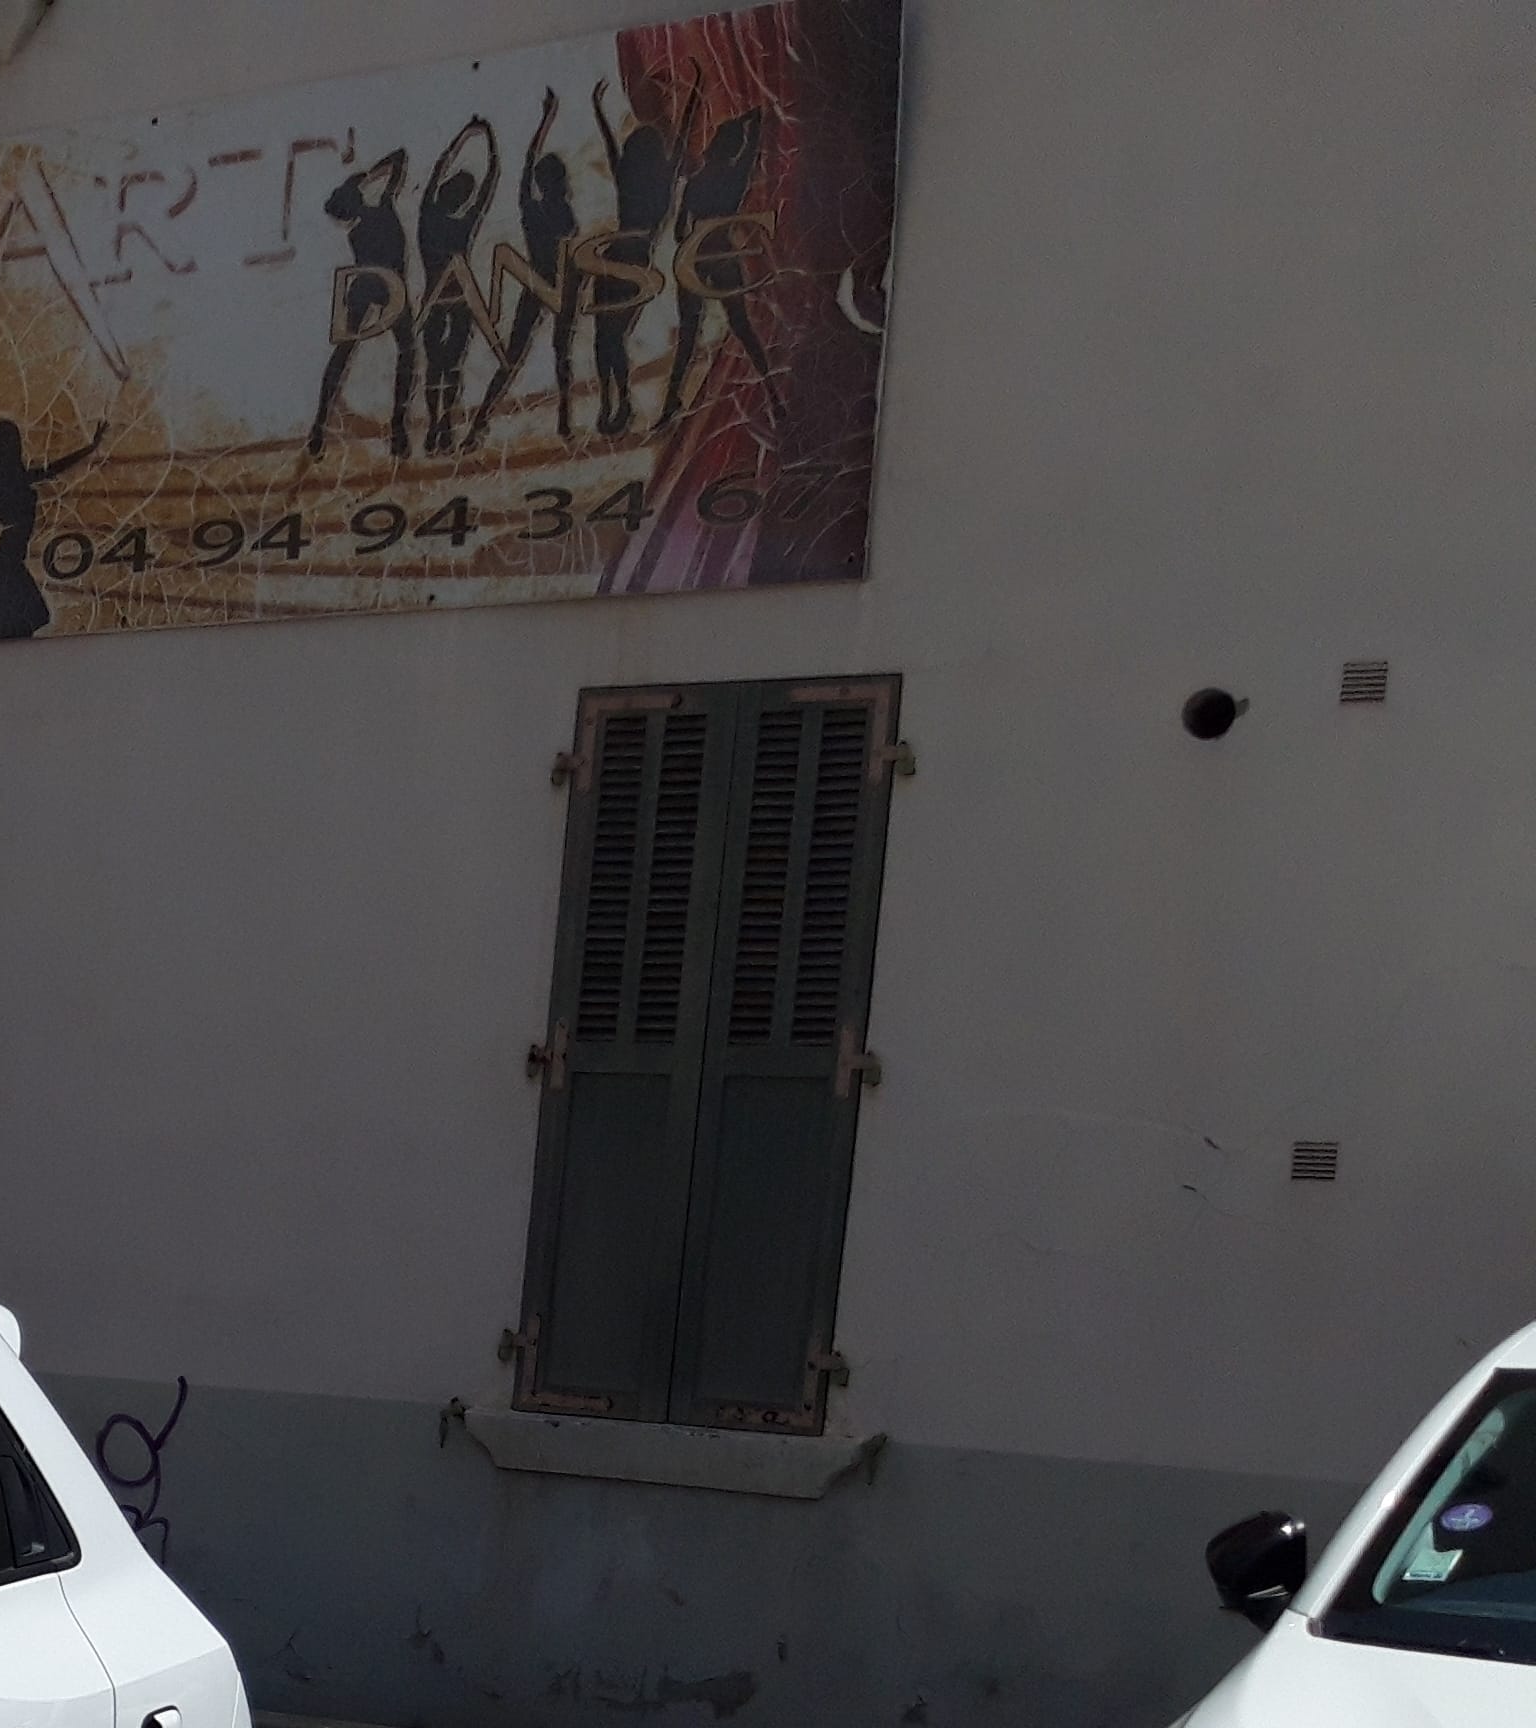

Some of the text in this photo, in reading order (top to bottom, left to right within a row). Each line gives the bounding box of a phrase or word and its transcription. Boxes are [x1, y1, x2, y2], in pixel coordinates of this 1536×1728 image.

[329, 210, 782, 372] DANSE
[43, 528, 156, 580] 04
[193, 512, 312, 567] 94
[349, 494, 481, 554] 94
[521, 479, 655, 542] 34
